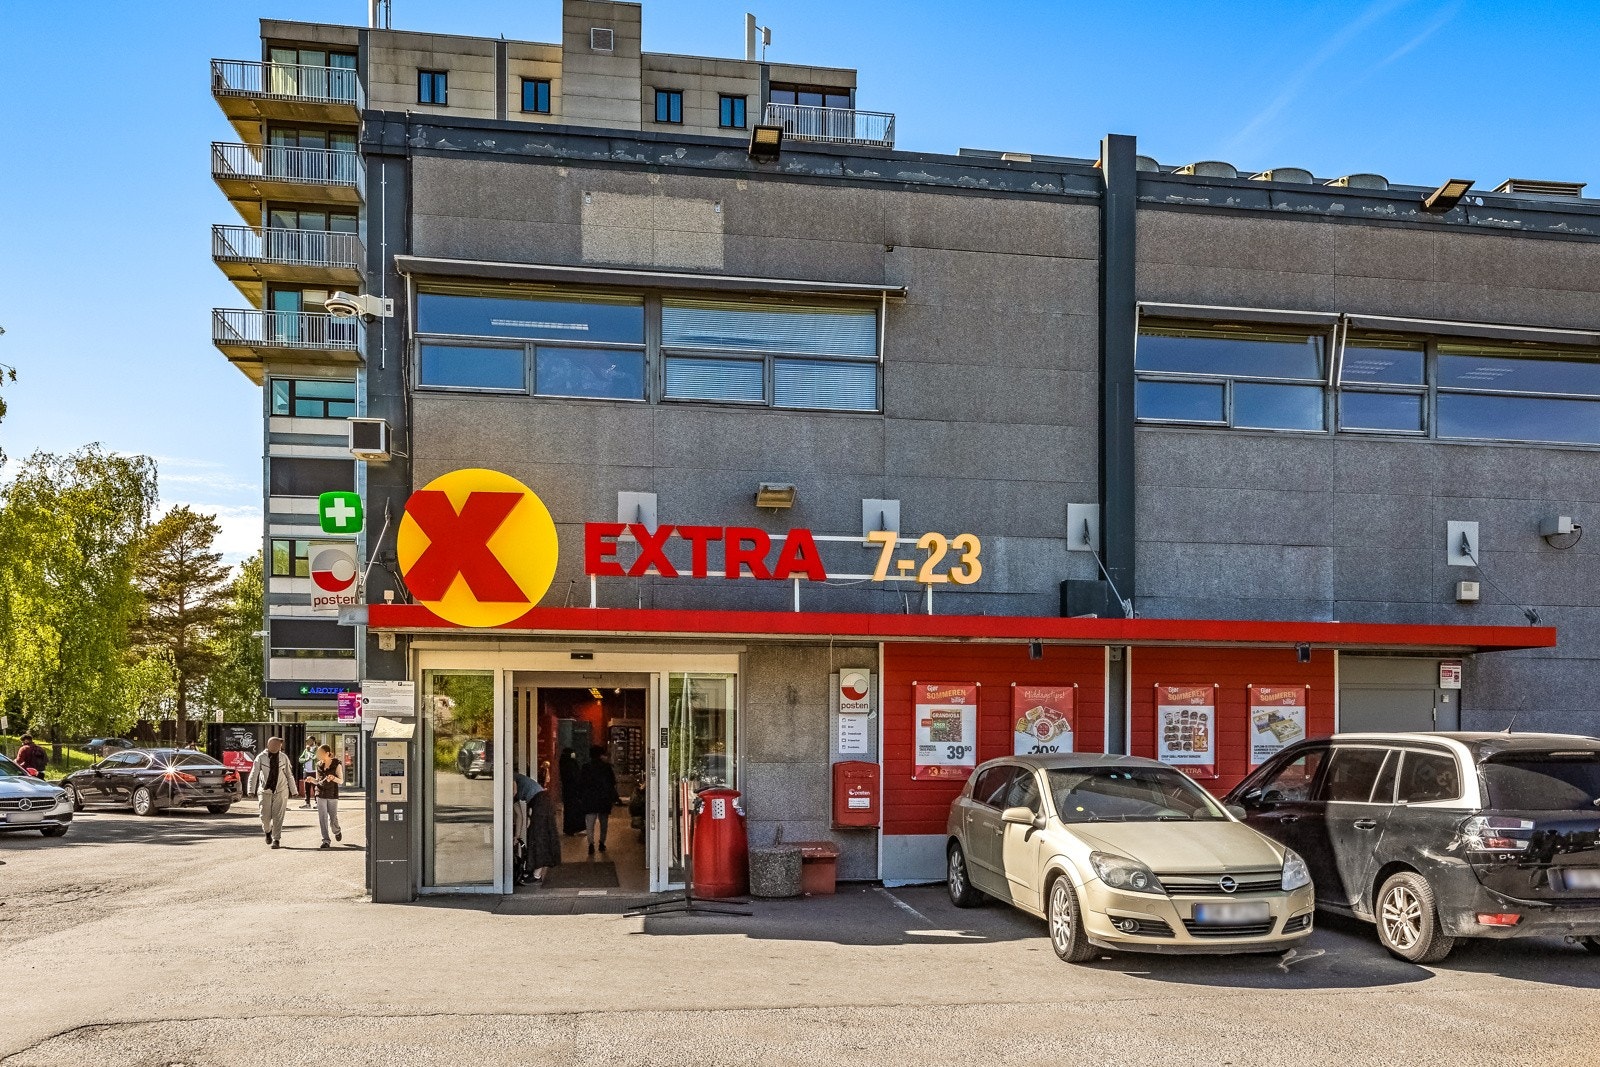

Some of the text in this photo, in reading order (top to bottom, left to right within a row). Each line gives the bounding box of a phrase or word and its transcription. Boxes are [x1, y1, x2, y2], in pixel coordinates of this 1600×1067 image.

[585, 522, 983, 584] EXTRA 7-23
[926, 690, 966, 699] SOMMEREN
[1167, 691, 1205, 700] SOMMEREN
[1260, 692, 1296, 701] SOMMEREN
[841, 702, 869, 710] posten
